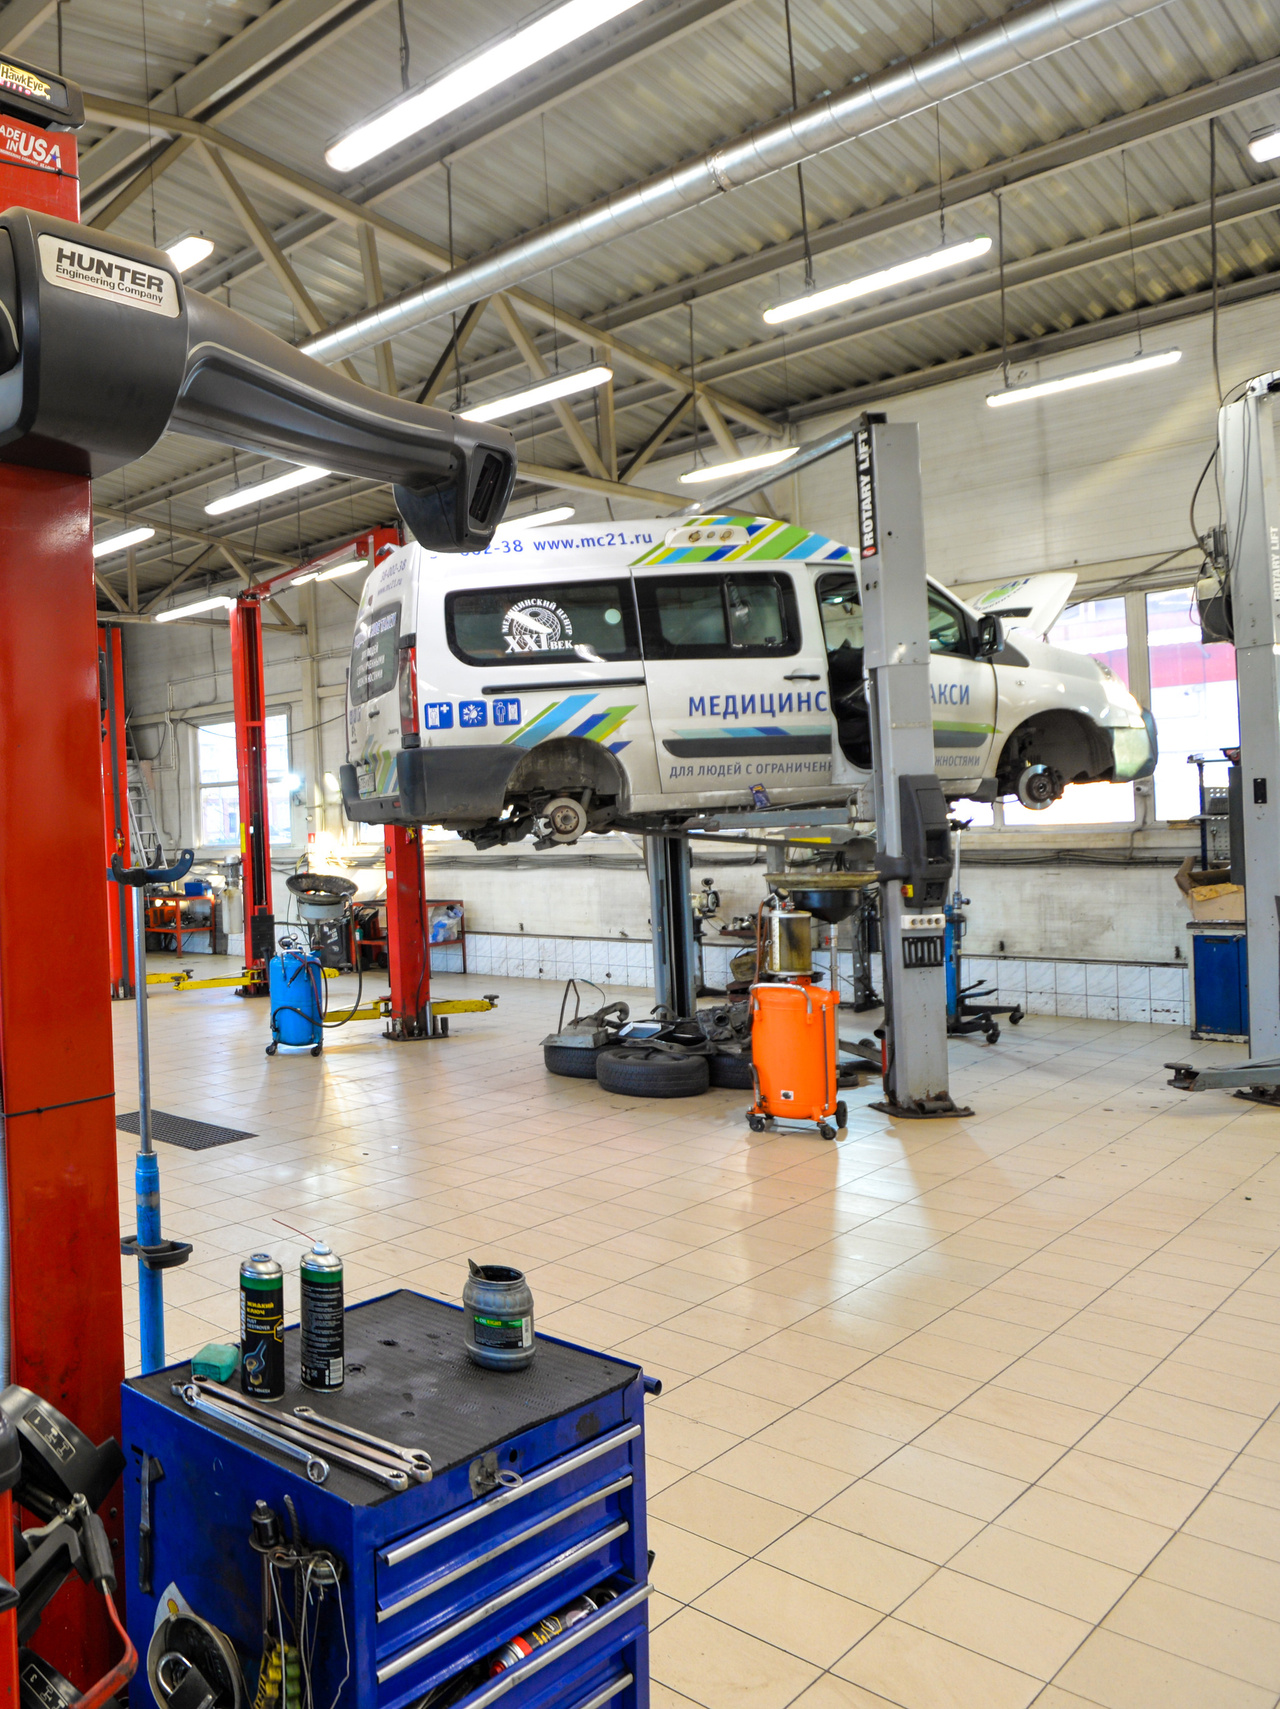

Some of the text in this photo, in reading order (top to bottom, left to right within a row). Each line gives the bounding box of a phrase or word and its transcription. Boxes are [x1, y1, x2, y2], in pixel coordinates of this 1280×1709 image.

[0, 66, 44, 92] HawkEye
[6, 132, 62, 168] IN USA
[55, 264, 164, 304] Engineering Company
[56, 247, 164, 293] HUNTER
[858, 430, 871, 470] LIFT
[861, 474, 875, 547] ROTARY
[533, 532, 653, 551] www.mc21.ru
[1270, 526, 1279, 550] LIFT
[501, 598, 573, 636] МЕДЦИНСКИЙ ЦЕНТР
[550, 640, 574, 650] ВЕК
[688, 690, 828, 720] МЕДИЦИНС
[669, 765, 694, 779] ДЛЯ
[697, 762, 742, 777] ЛЮДЕЙ
[745, 763, 753, 774] С
